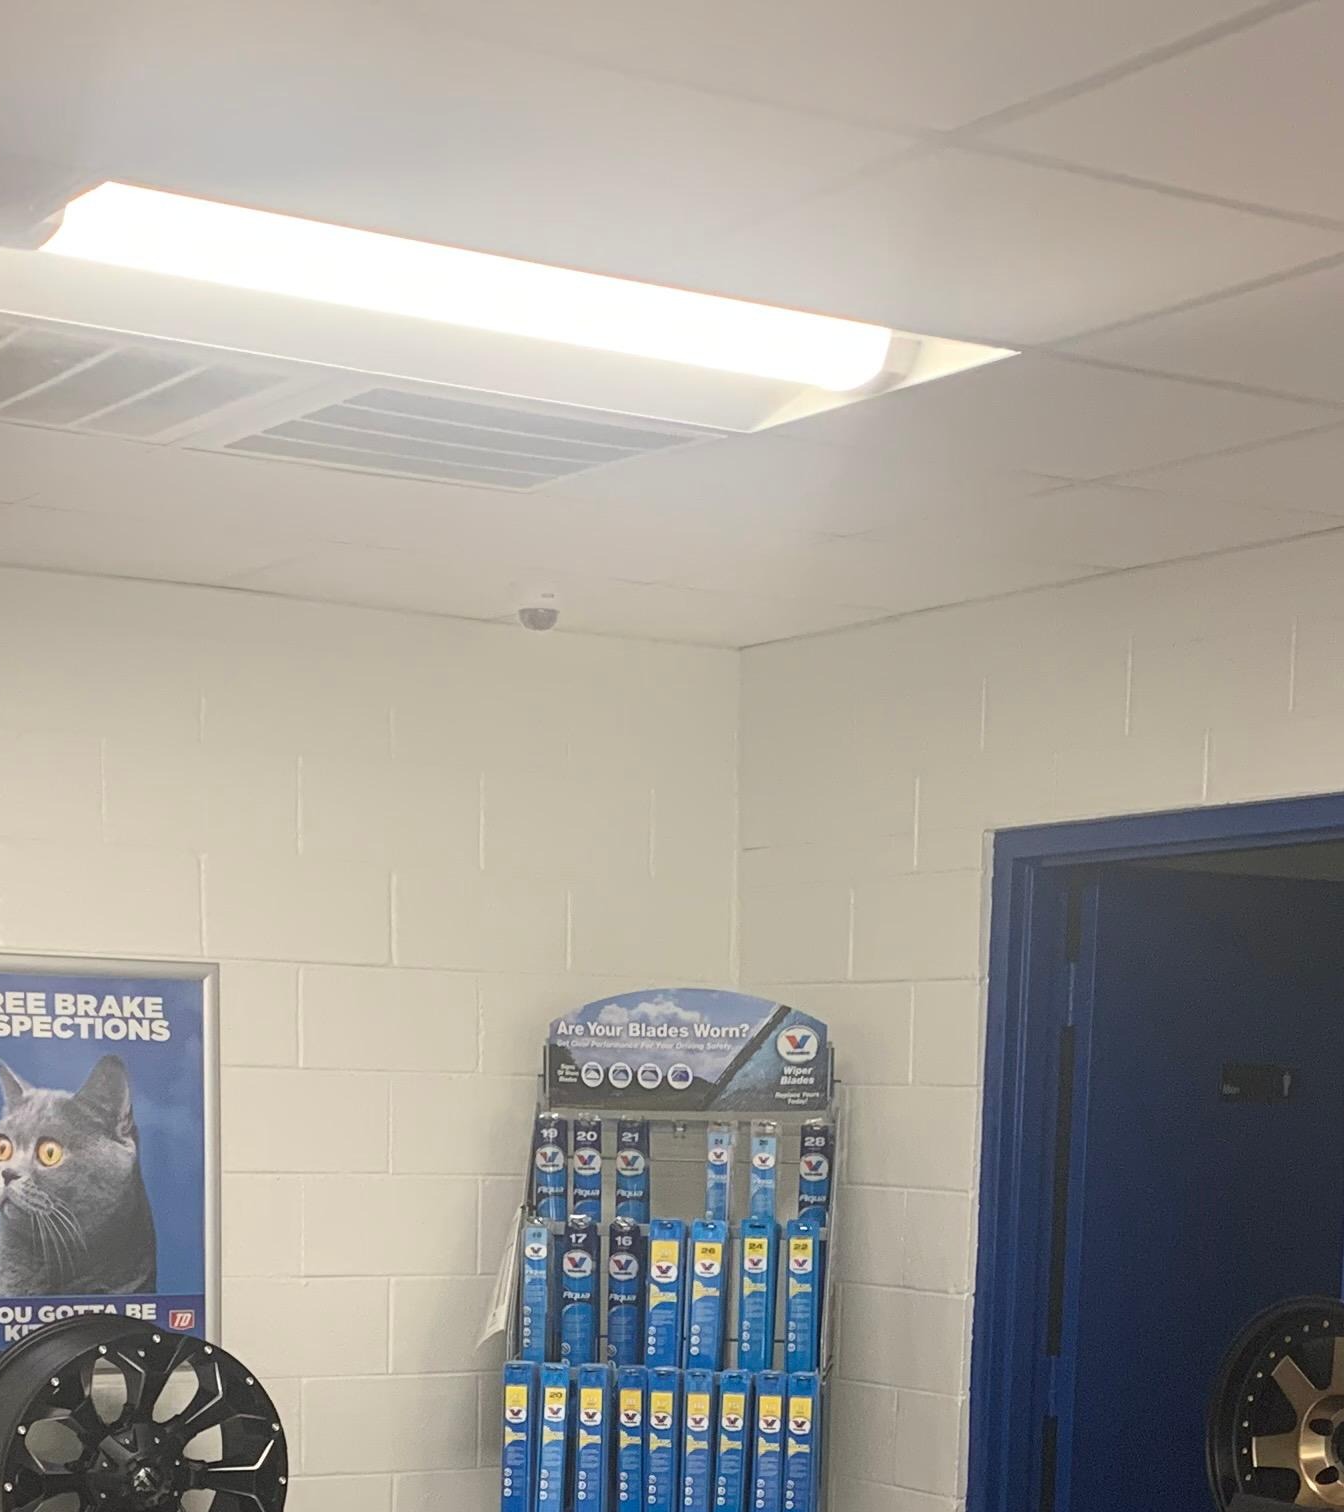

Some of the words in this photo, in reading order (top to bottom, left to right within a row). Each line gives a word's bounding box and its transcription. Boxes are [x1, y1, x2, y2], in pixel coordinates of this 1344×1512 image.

[54, 993, 164, 1018] BRAKE
[557, 1021, 584, 1037] Are
[586, 1022, 623, 1037] Your
[628, 1023, 689, 1038] Blades
[693, 1023, 750, 1038] Worn?
[783, 1066, 814, 1076] Wiper
[780, 1076, 815, 1085] Blades
[540, 1128, 558, 1138] 19
[576, 1131, 598, 1141] 20
[621, 1132, 639, 1142] 21
[804, 1137, 825, 1147] 28
[537, 1186, 564, 1196] Aqua
[573, 1186, 600, 1197] Aqua
[616, 1189, 644, 1198] Aqua
[799, 1194, 827, 1204] Aqua
[569, 1233, 587, 1243] 17
[615, 1236, 633, 1246] 16
[562, 1291, 590, 1301] Aqua
[609, 1293, 637, 1303] Aqua
[125, 1303, 157, 1320] BE
